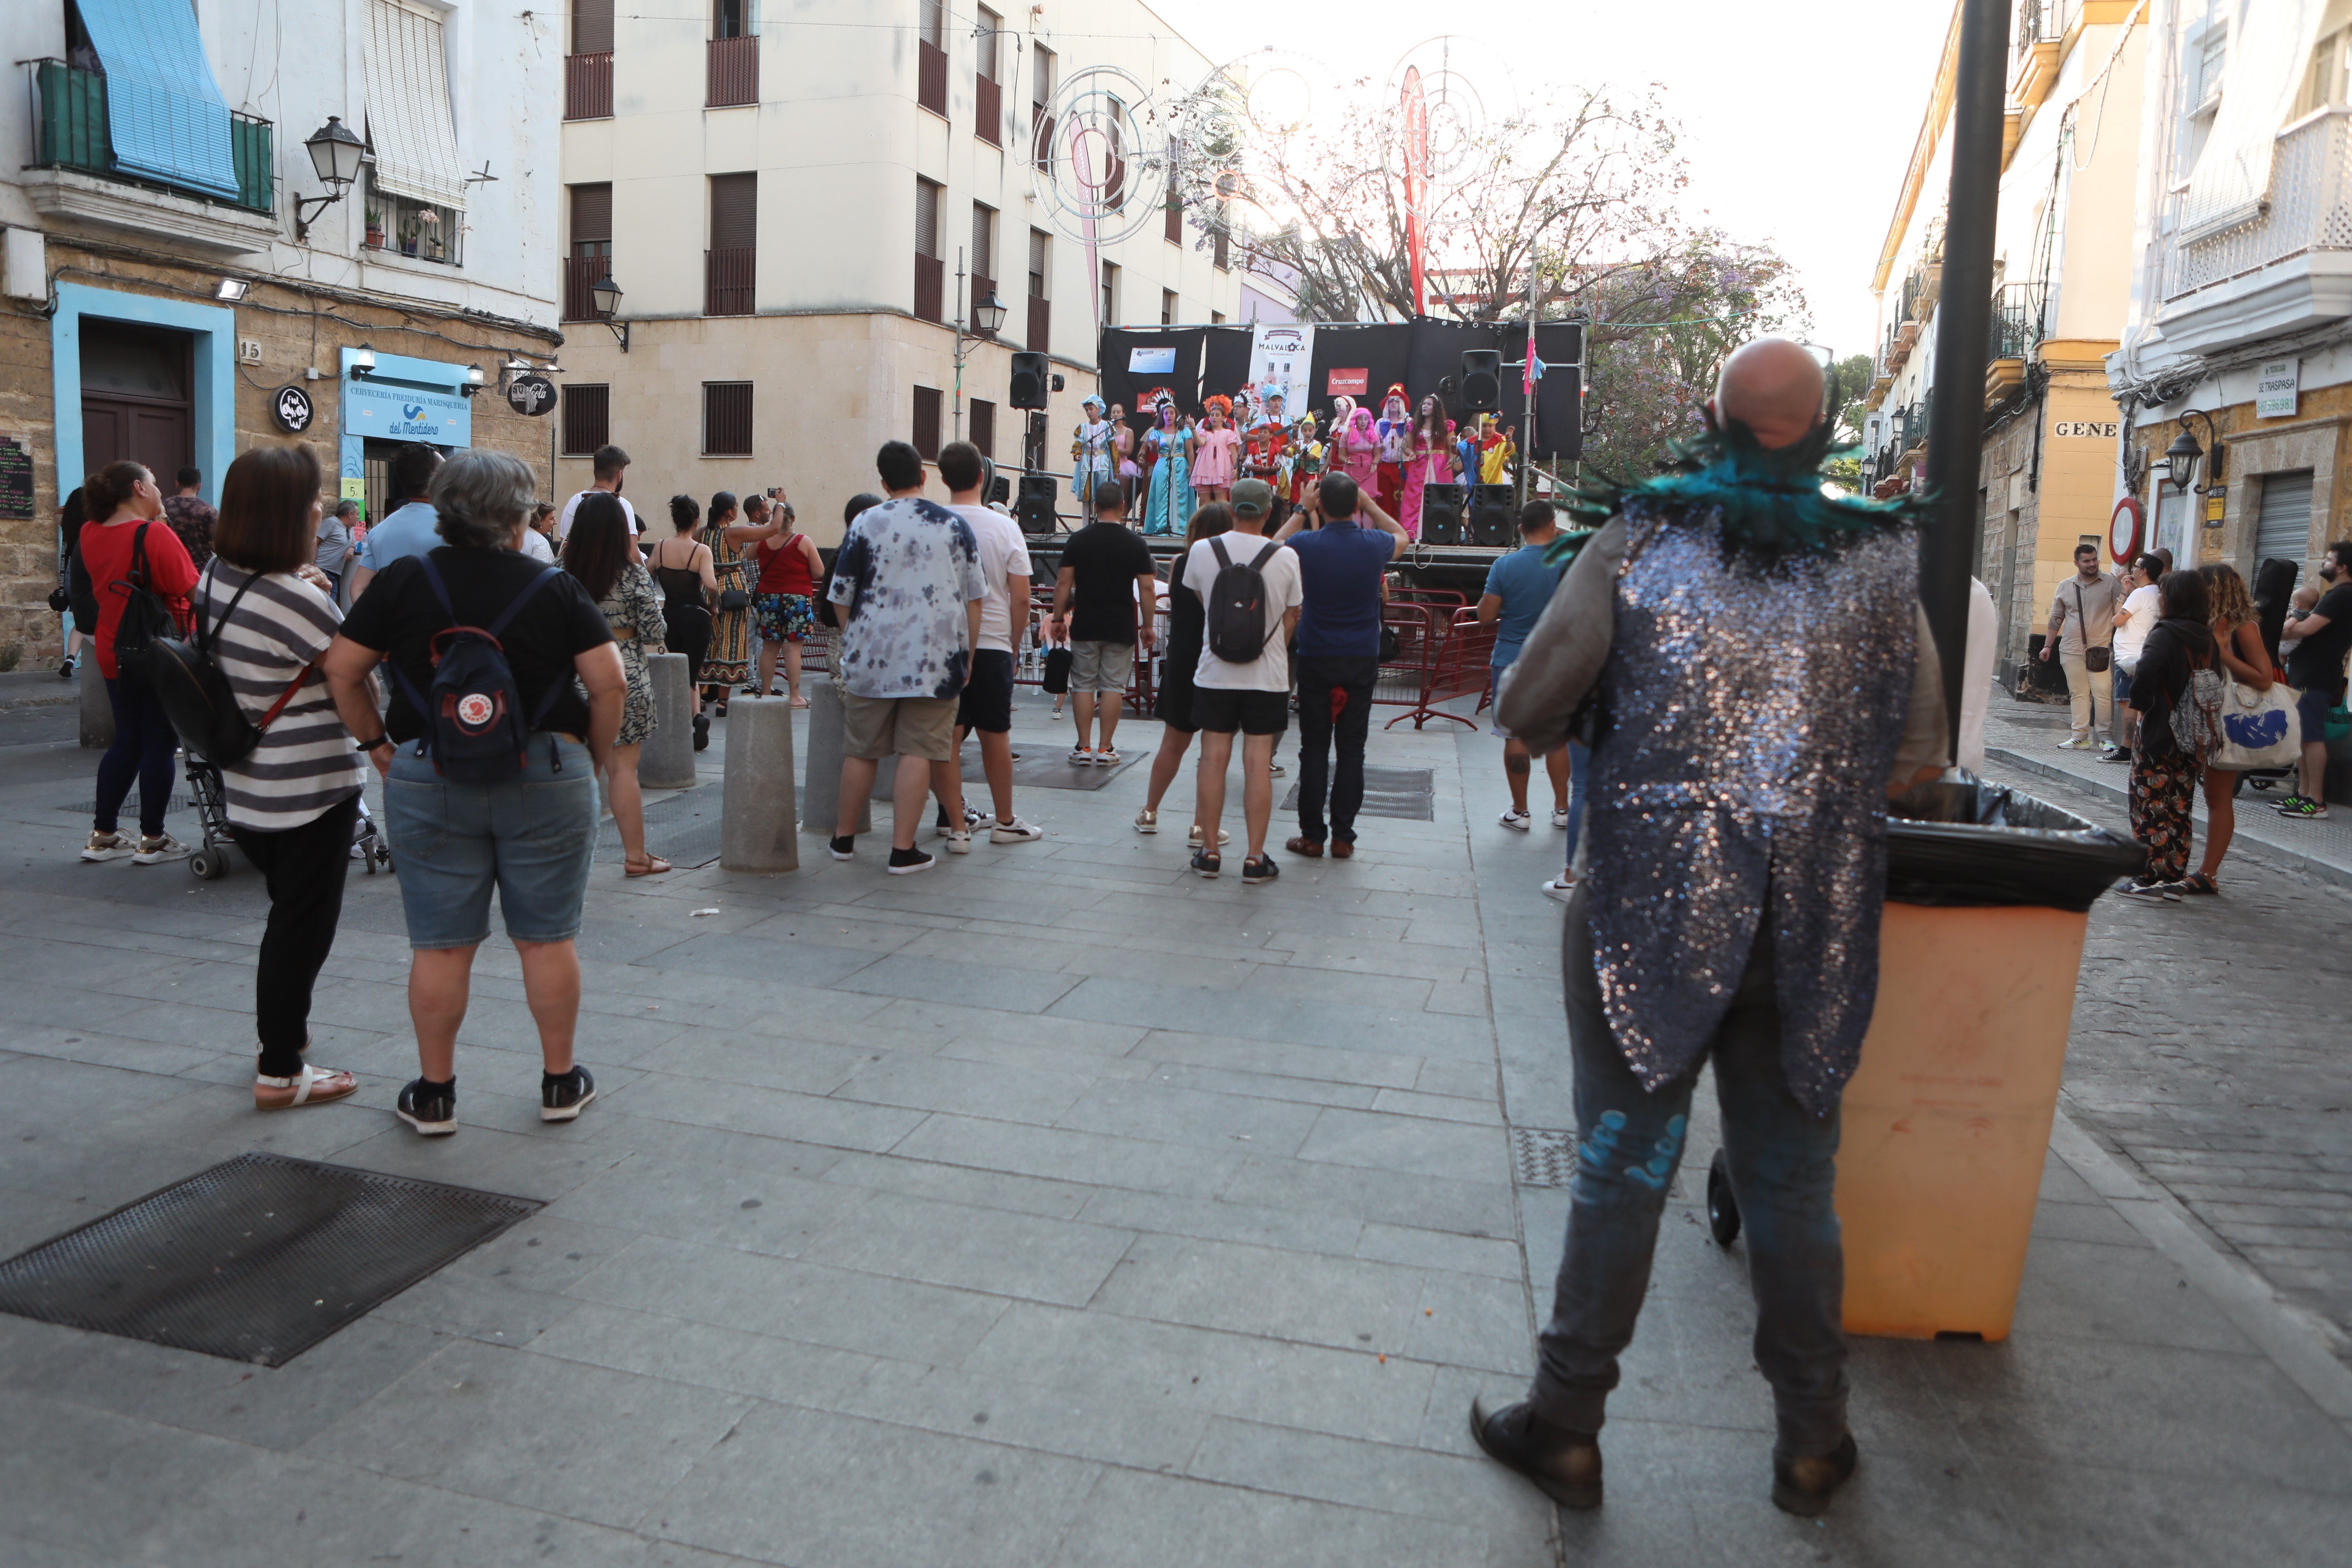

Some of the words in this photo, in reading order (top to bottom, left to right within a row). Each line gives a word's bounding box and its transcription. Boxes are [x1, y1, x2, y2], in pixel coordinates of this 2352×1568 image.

[241, 342, 259, 358] 15
[1259, 342, 1305, 352] MALVALOCA
[2258, 383, 2264, 393] SE
[2265, 379, 2295, 392] TRASPASA
[350, 387, 391, 399] CERVECERÍA
[393, 393, 426, 404] FREIDURÍA
[427, 398, 468, 410] MARISQUERÍA
[389, 422, 401, 434] del
[403, 422, 438, 435] Mentidero
[2056, 423, 2116, 436] GENE
